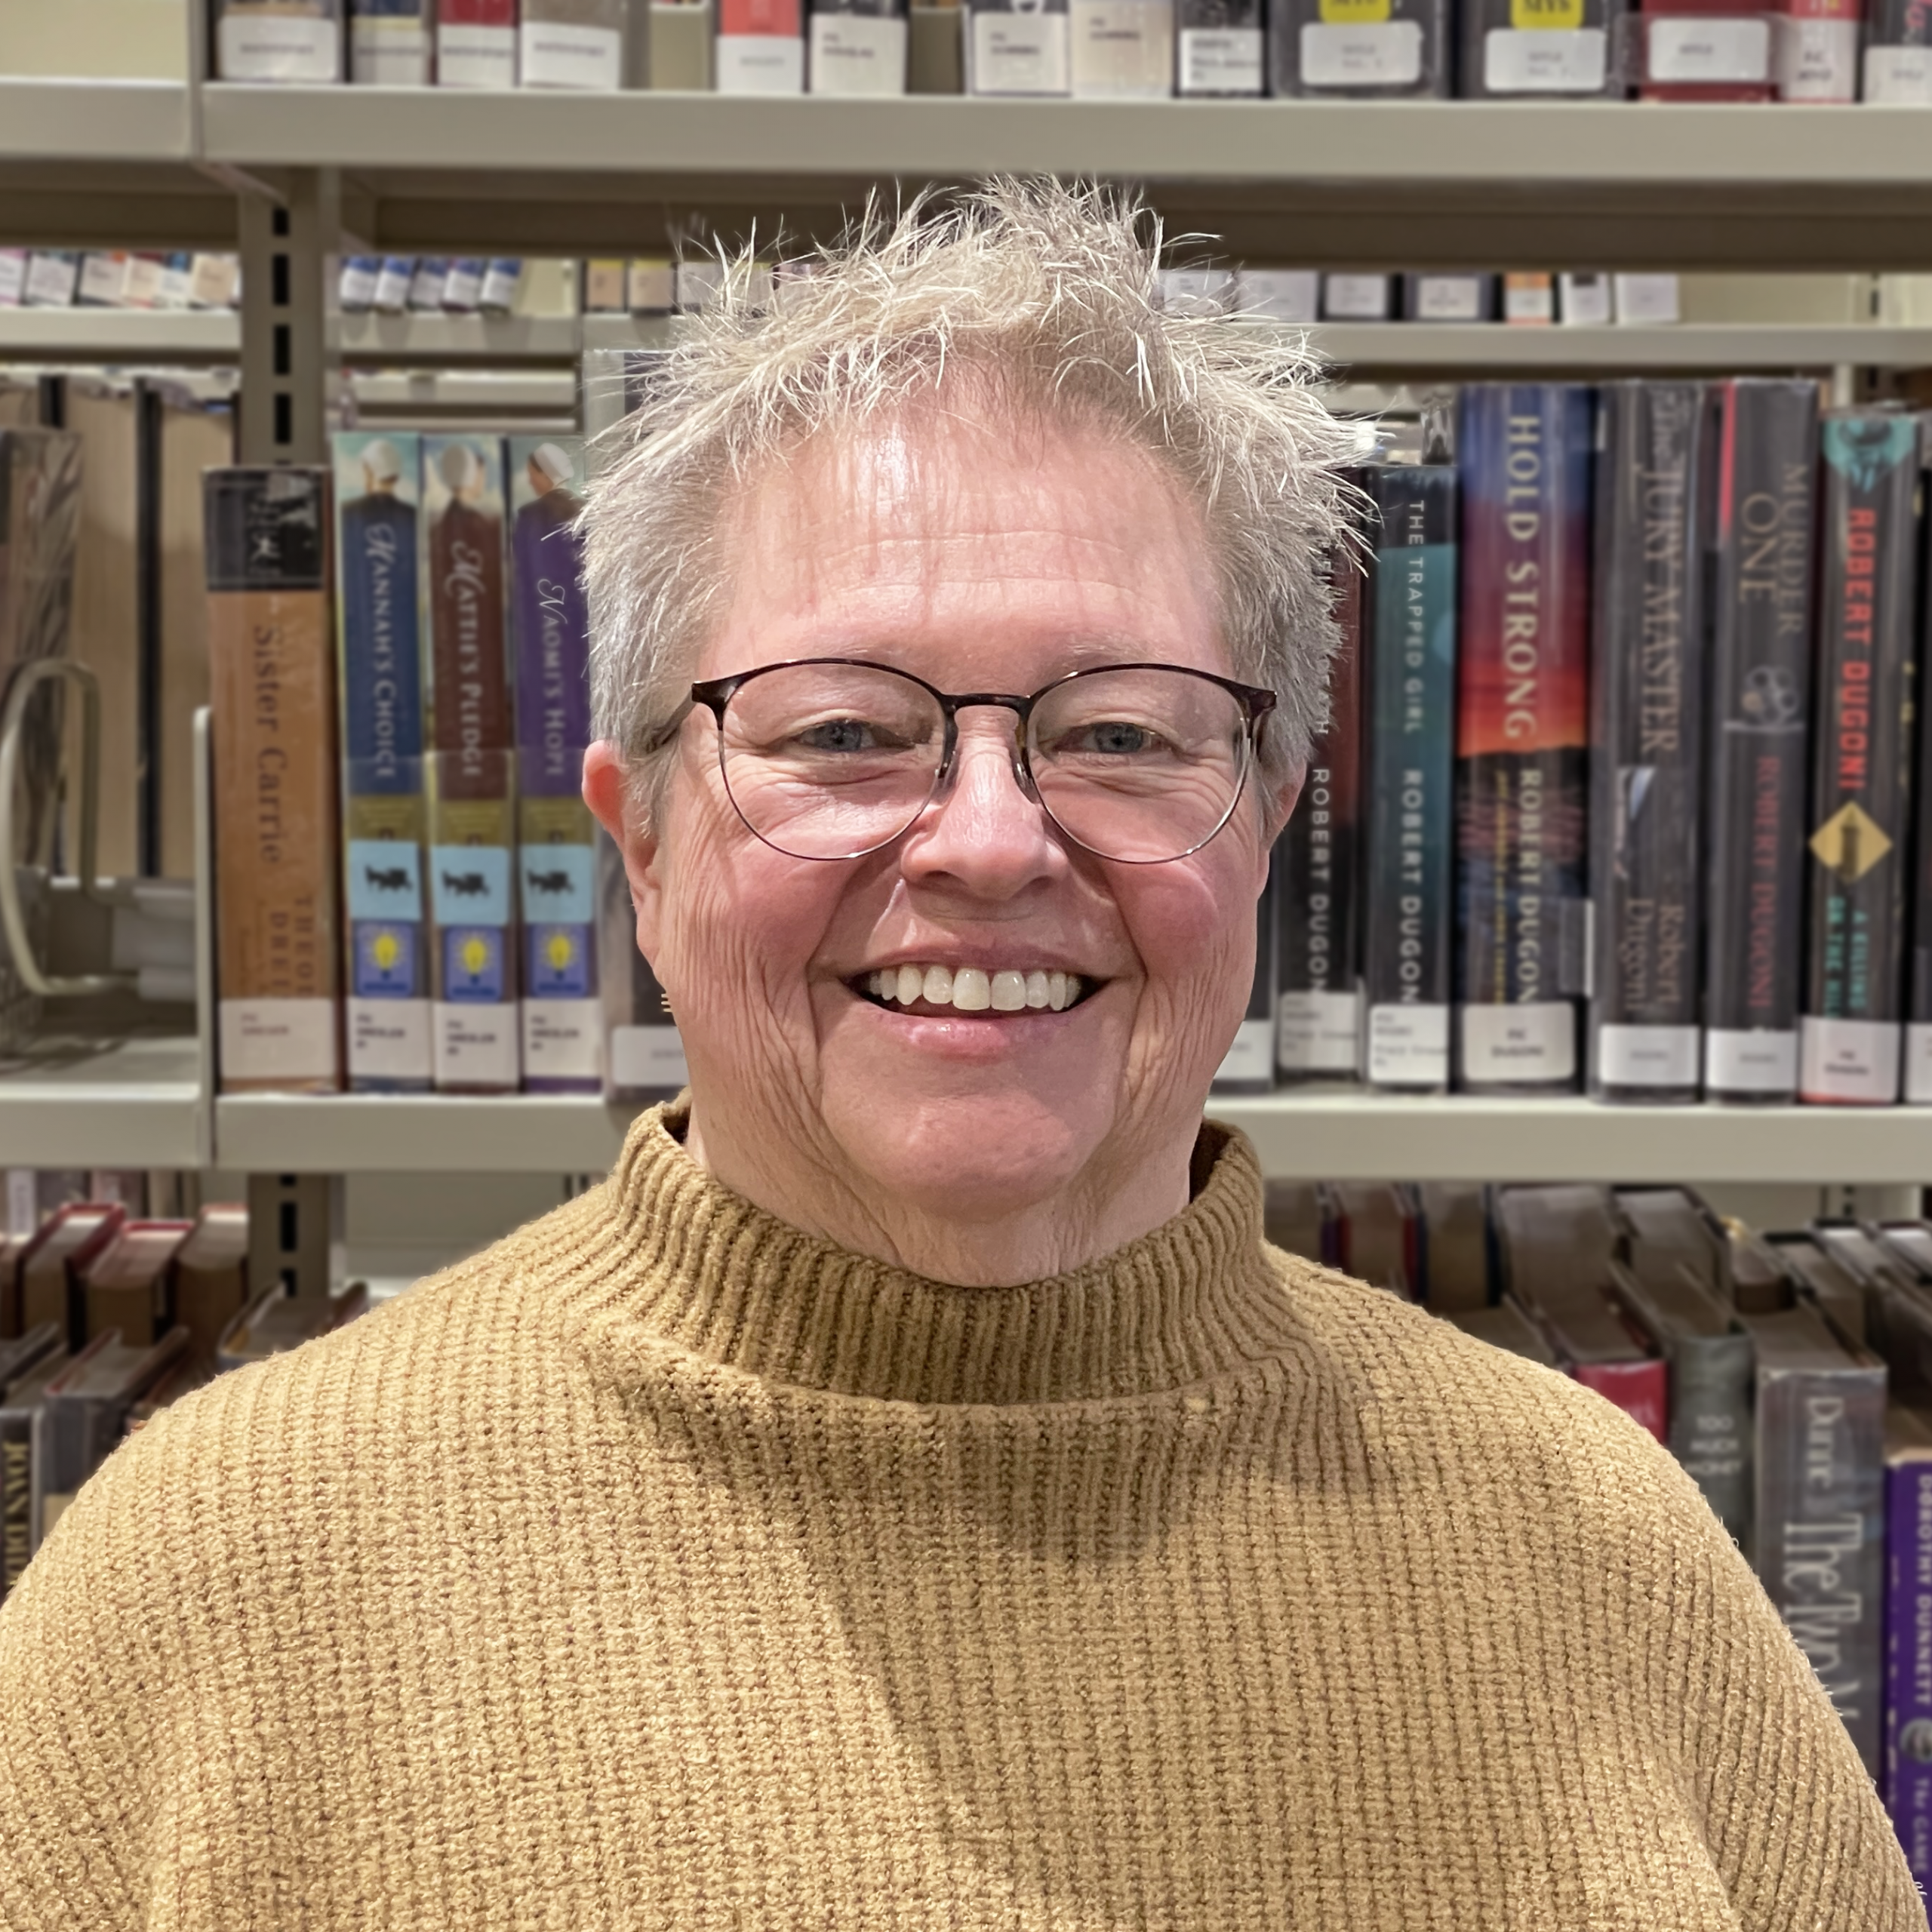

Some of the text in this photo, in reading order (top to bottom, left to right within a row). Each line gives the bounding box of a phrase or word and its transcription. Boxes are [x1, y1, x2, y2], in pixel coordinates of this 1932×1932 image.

[1632, 454, 1684, 570] JURY
[1738, 493, 1780, 604] ONE
[1778, 463, 1808, 635] MURDER
[1404, 500, 1424, 734] THE TRAPPED GIRL
[1503, 416, 1541, 738] HOLD STRONG
[254, 626, 282, 731] Sister
[1641, 583, 1681, 753] MASTER
[1838, 509, 1876, 789] ROBERT DUGONI
[374, 680, 395, 777] CHOICE
[461, 683, 483, 777] PLEDGE
[544, 709, 565, 777] HOPE
[256, 748, 287, 866] Carrie
[1310, 768, 1331, 881] ROBERT
[1401, 770, 1423, 884] ROBERT
[1518, 769, 1543, 885] ROBERT
[1749, 756, 1780, 1008] ROBERT DUGONI
[1657, 903, 1685, 1004] Robert
[1685, 1459, 1742, 1477] MONEY
[1690, 1438, 1739, 1454] MUCH
[1696, 1415, 1734, 1432] TOO
[1806, 1397, 1844, 1489] Dunne
[1783, 1512, 1863, 1594] The
[1915, 1474, 1932, 1704] DOROTHY DUNNETT
